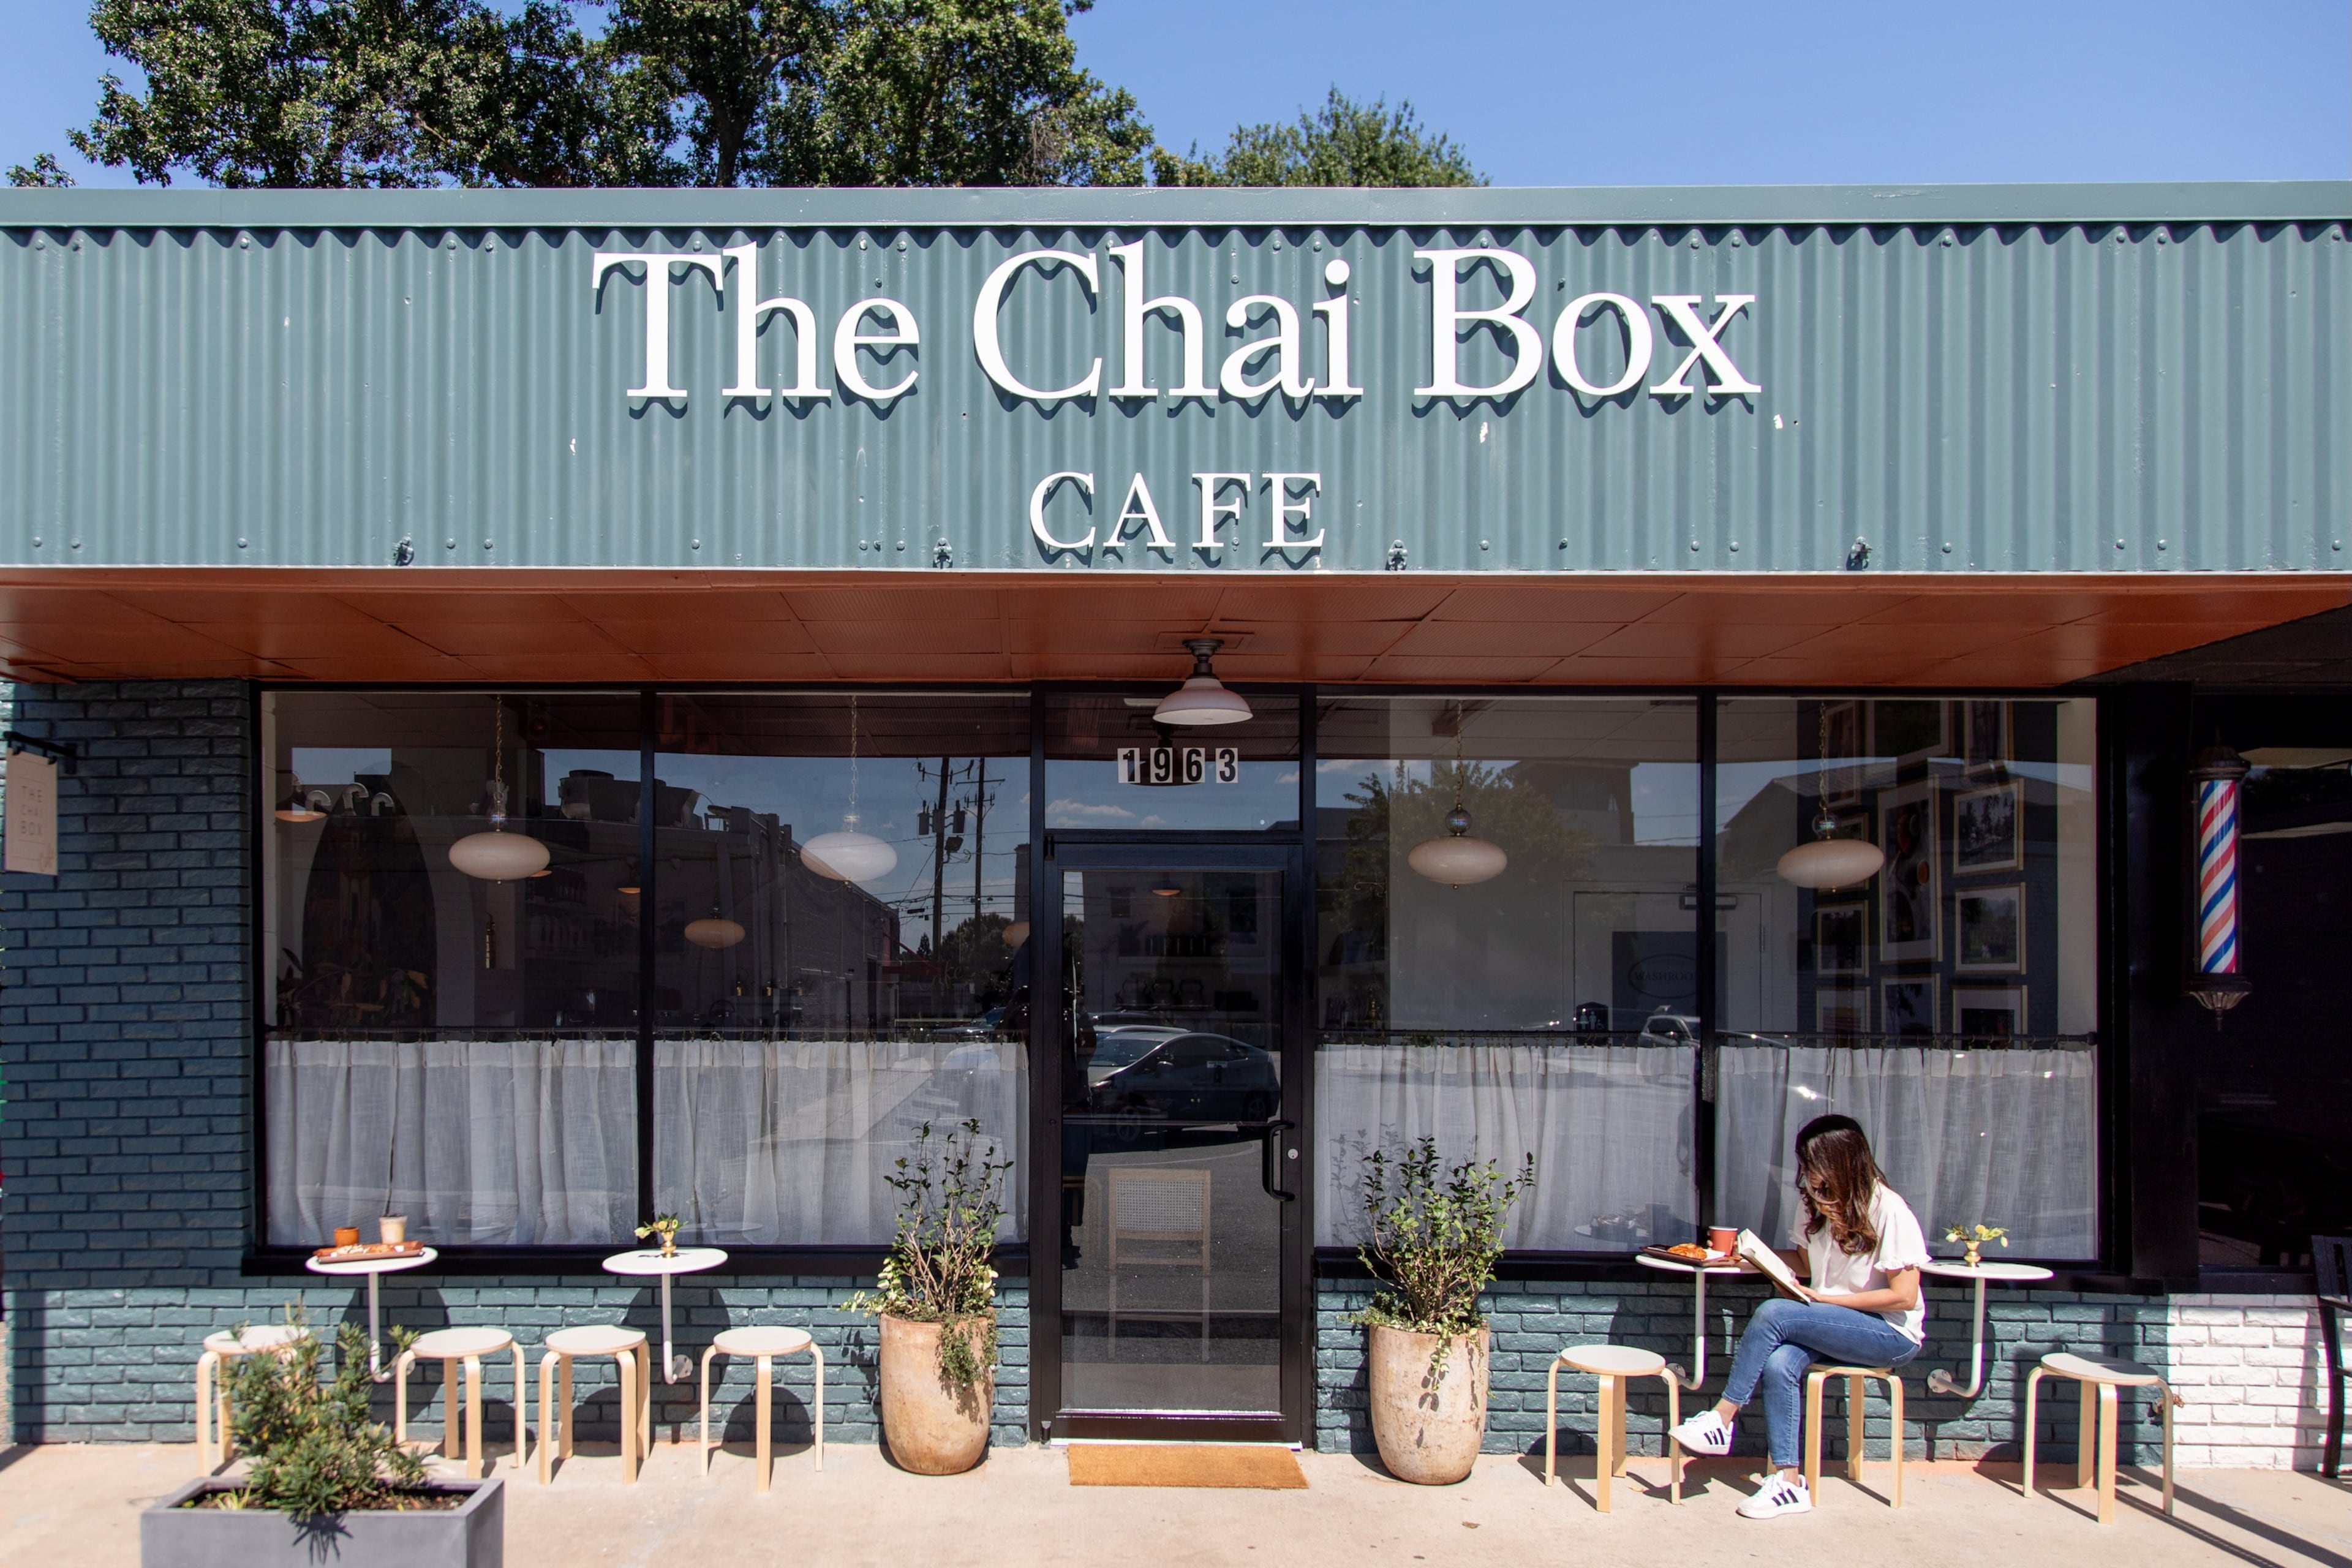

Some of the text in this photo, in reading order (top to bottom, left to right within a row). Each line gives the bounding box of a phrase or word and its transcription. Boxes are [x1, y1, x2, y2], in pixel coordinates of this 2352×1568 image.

[592, 239, 1762, 399] The Chai Box
[1030, 472, 1325, 549] CAFE
[1121, 748, 1236, 783] 1963
[20, 785, 43, 803] THE
[20, 820, 43, 837] BOX
[1634, 971, 1696, 982] WASHROO
